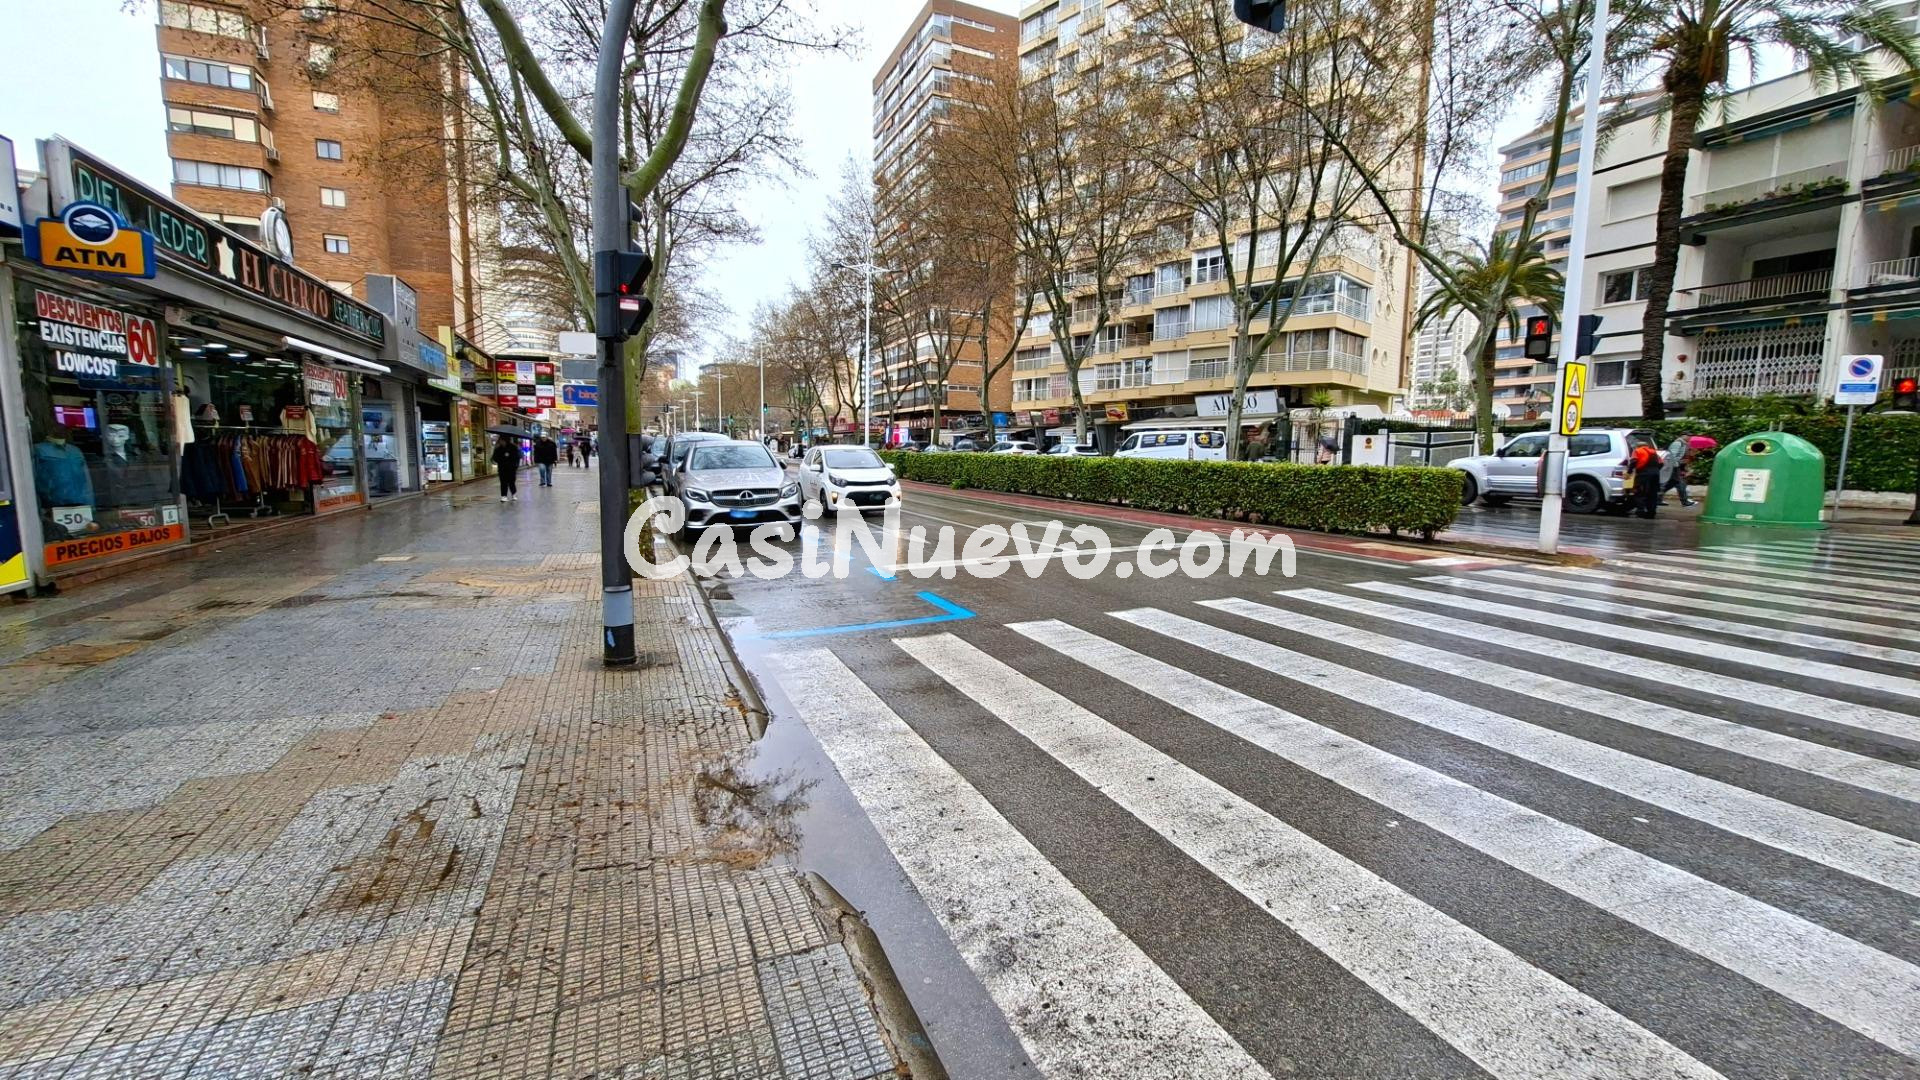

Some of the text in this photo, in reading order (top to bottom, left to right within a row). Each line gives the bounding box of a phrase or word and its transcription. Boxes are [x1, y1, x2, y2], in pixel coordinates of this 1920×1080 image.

[148, 205, 207, 263] LEDER
[55, 246, 127, 268] ATM
[239, 247, 329, 318] EL CIERVO
[37, 291, 124, 334] DESCUENTOS
[40, 320, 127, 354] EXISTENCIAS
[127, 316, 157, 366] 60
[56, 350, 118, 377] LOWCOST
[55, 527, 171, 561] PRECIOS BAJOS
